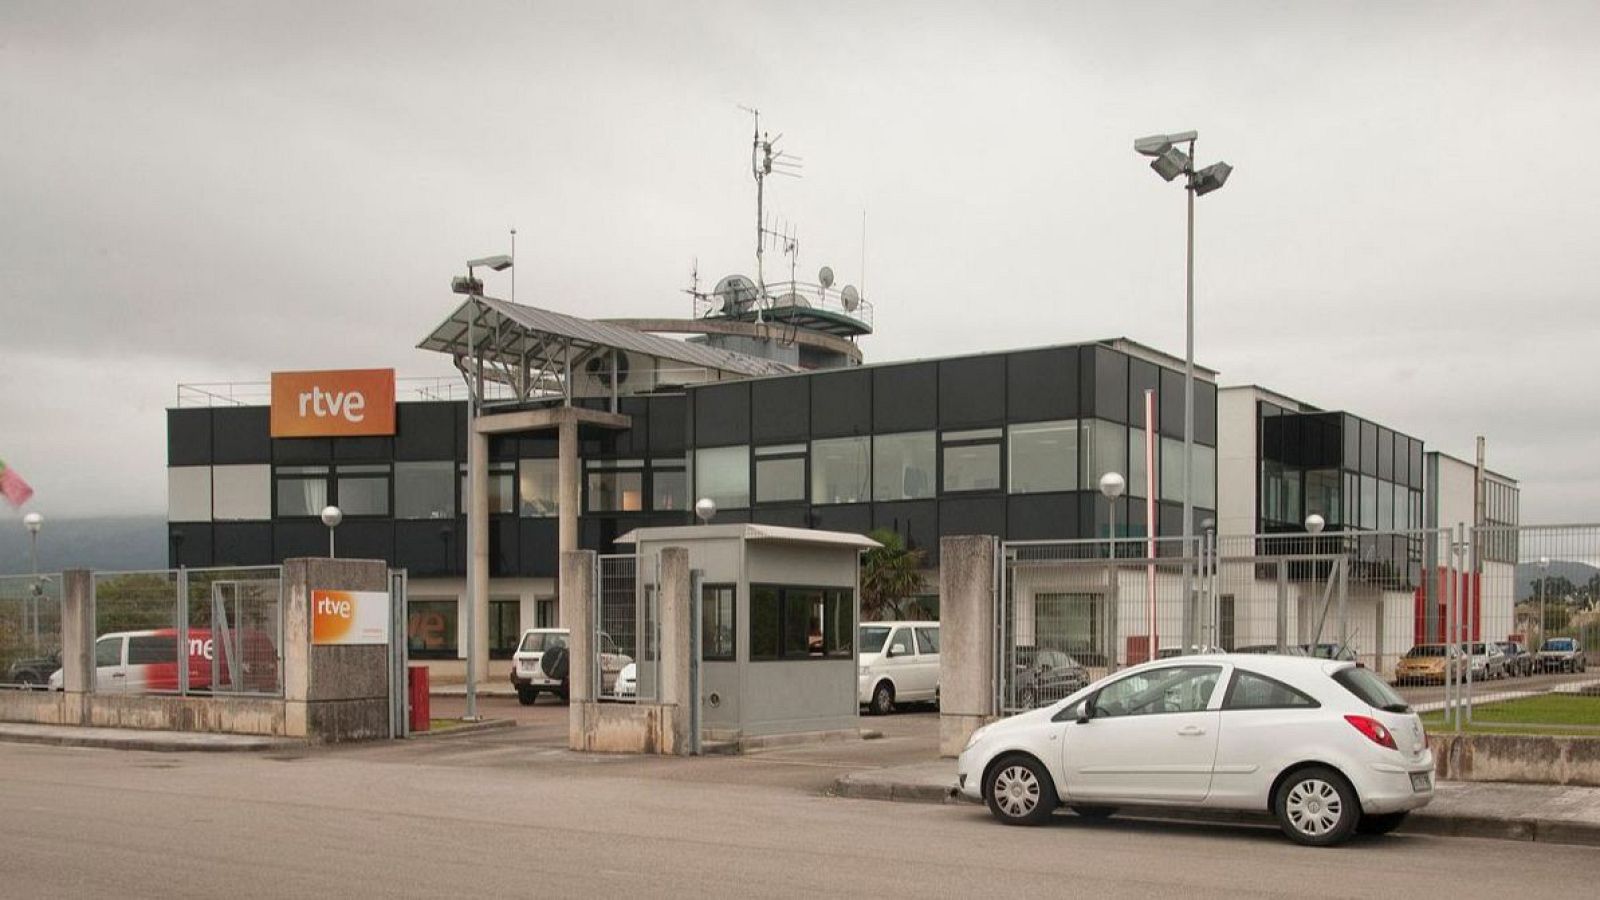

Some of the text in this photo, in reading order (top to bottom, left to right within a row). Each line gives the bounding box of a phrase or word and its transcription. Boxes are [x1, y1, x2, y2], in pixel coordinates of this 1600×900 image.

[299, 386, 365, 422] rtve
[318, 596, 351, 618] rtve
[408, 612, 446, 646] ve
[188, 639, 213, 660] ne
